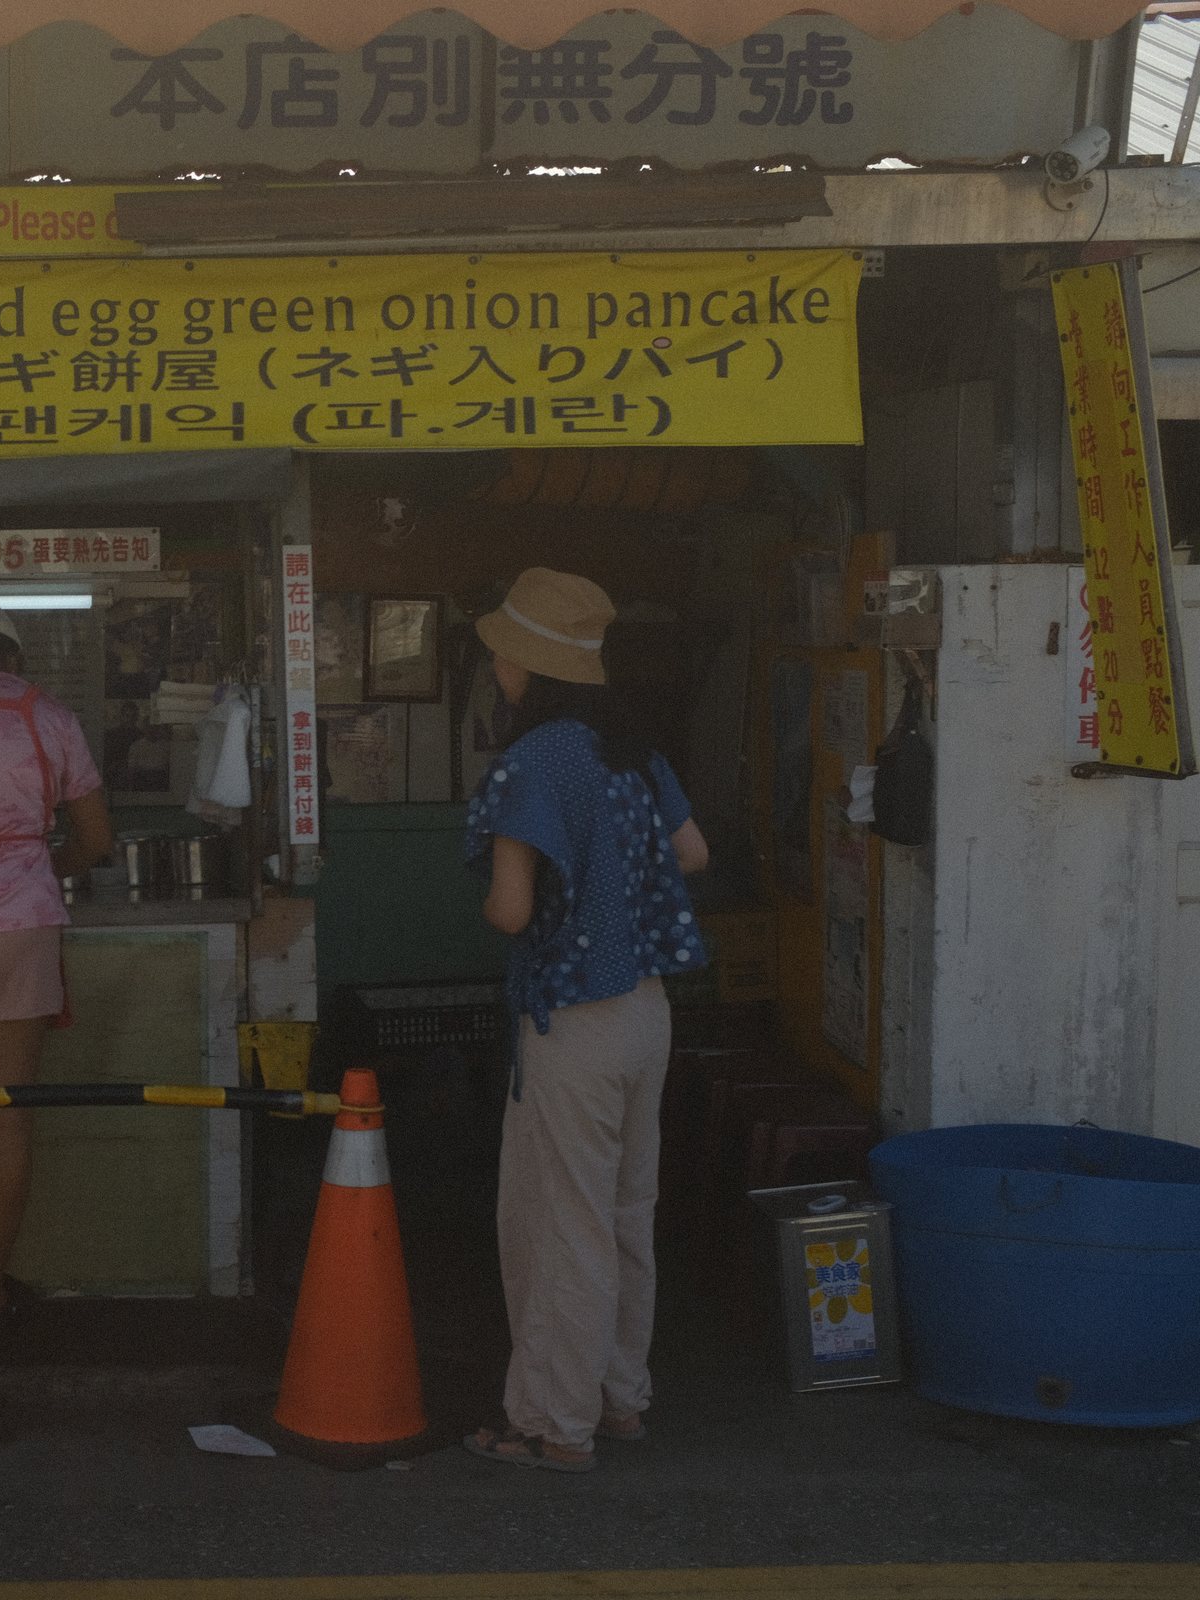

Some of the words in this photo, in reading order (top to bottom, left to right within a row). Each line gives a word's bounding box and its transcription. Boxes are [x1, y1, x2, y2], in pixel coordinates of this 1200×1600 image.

[110, 30, 853, 131] 本店別無分號
[51, 298, 160, 347] egg
[183, 294, 356, 346] green
[380, 278, 560, 331] onion
[586, 275, 831, 340] pancake
[291, 394, 672, 445] (파.계란)
[31, 535, 150, 564] 蛋要熟先告知
[291, 710, 315, 836] 拿到餅再付錢
[815, 1263, 861, 1284] 美食家
